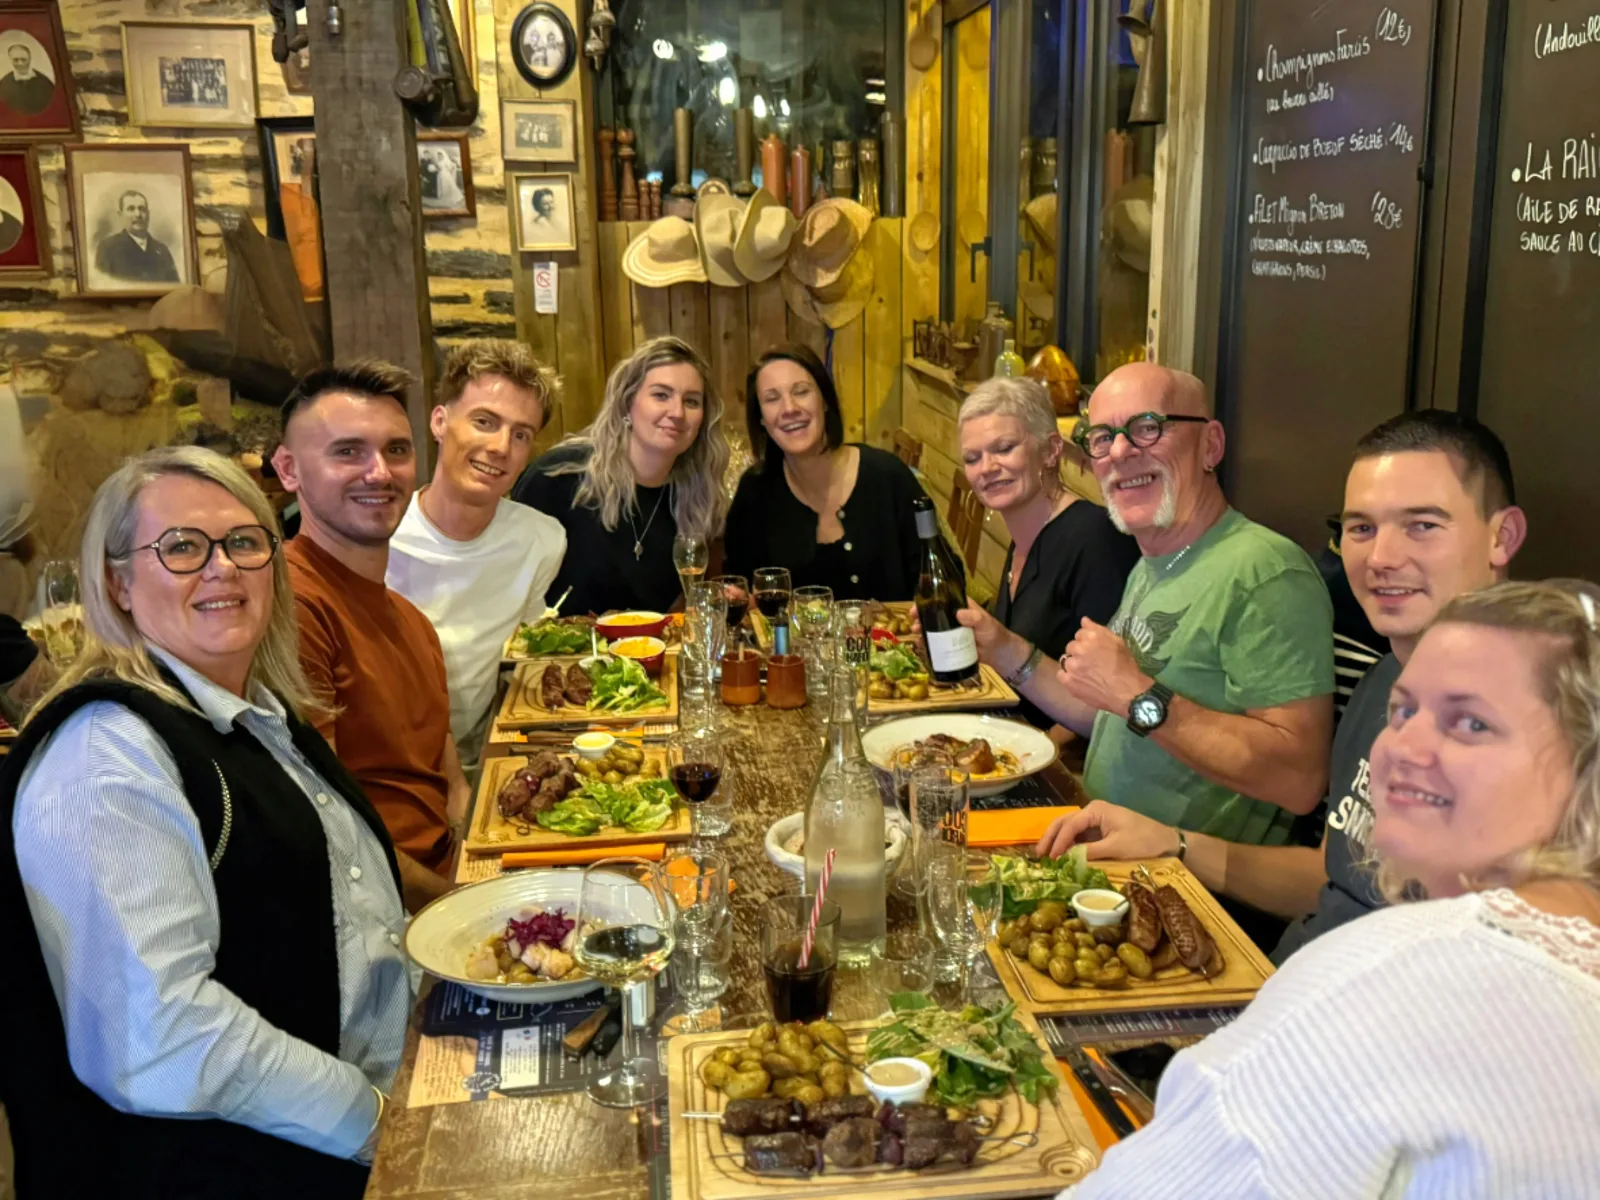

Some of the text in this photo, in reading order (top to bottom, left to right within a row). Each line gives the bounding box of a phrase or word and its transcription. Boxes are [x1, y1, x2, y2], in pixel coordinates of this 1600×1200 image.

[1524, 141, 1553, 182] LA
[1557, 198, 1579, 224] DE
[1520, 230, 1562, 254] SAUCE
[1568, 229, 1584, 252] AU
